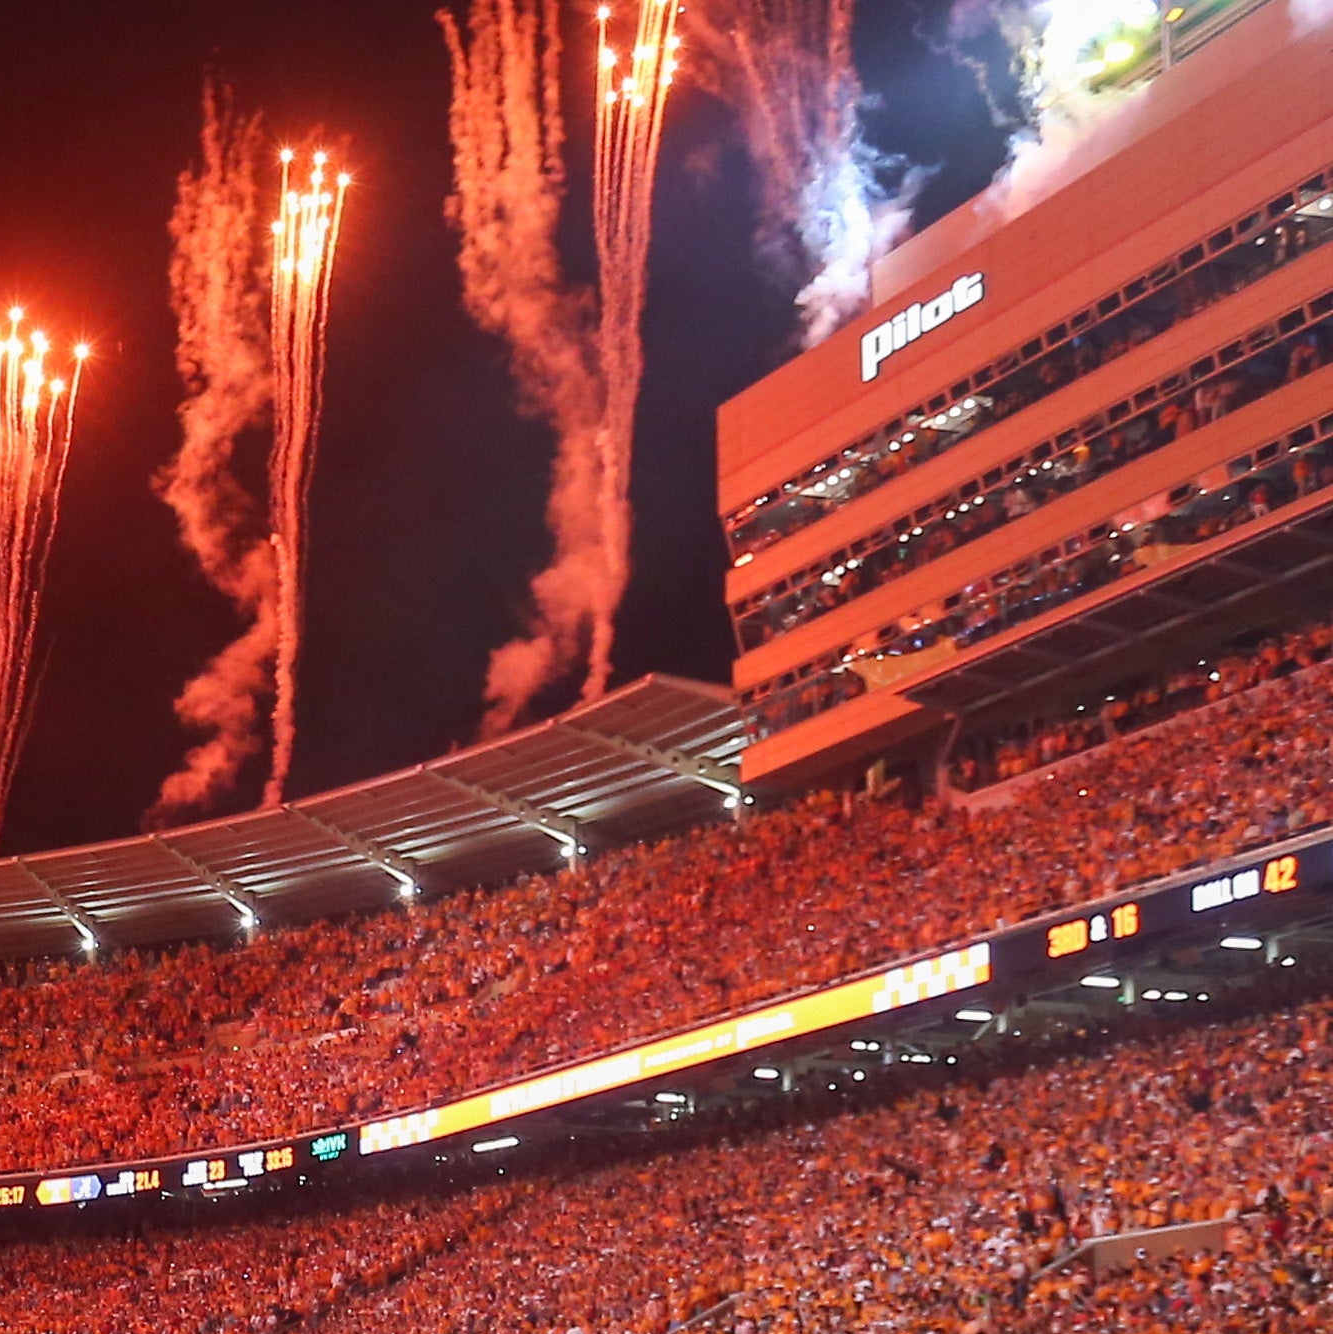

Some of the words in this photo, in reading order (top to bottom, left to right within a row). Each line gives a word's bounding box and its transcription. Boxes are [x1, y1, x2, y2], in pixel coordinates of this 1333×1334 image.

[861, 272, 983, 382] pilot
[1263, 855, 1298, 893] 42
[1111, 903, 1139, 939] 16
[136, 1170, 160, 1190] 21.4
[209, 1160, 225, 1180] 23
